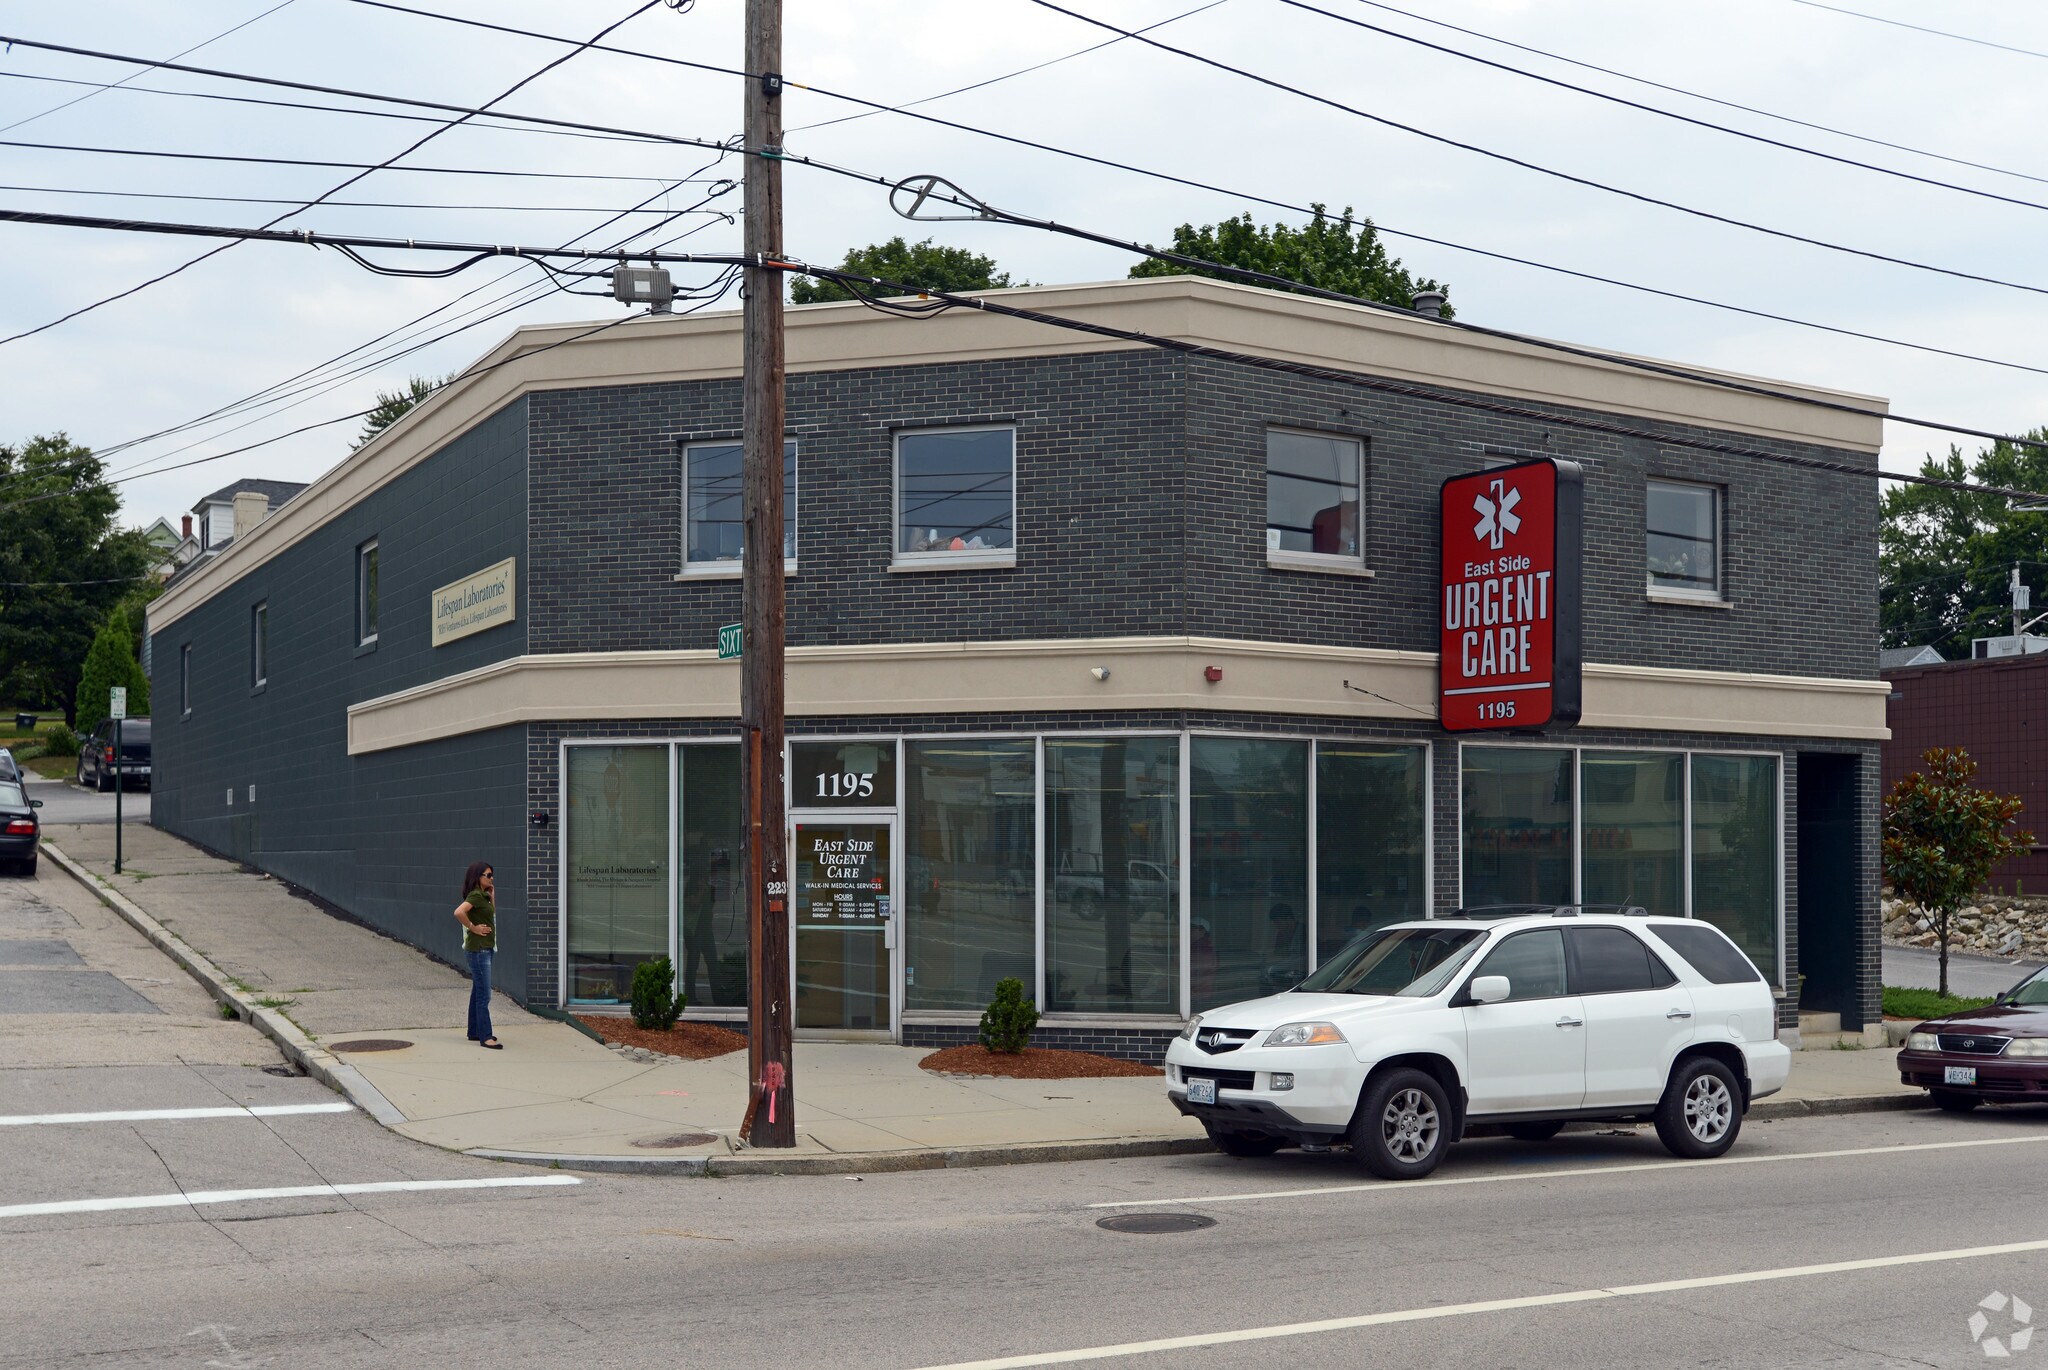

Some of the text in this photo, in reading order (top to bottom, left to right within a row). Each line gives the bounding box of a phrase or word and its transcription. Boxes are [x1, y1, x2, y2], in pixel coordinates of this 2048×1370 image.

[1465, 555, 1531, 578] East Side
[437, 596, 462, 619] Lifespan
[1446, 571, 1551, 630] URGENT
[485, 602, 508, 618] Laboratories
[720, 629, 742, 655] SIXT
[1462, 625, 1531, 677] CARE
[1478, 702, 1516, 720] 1195
[815, 772, 874, 797] 1195
[814, 839, 874, 852] EAST SIDE
[820, 852, 867, 865] URGENT
[578, 866, 609, 875] Lifespan
[827, 866, 860, 878] CARE
[767, 881, 787, 894] 223
[834, 893, 853, 901] HOURS
